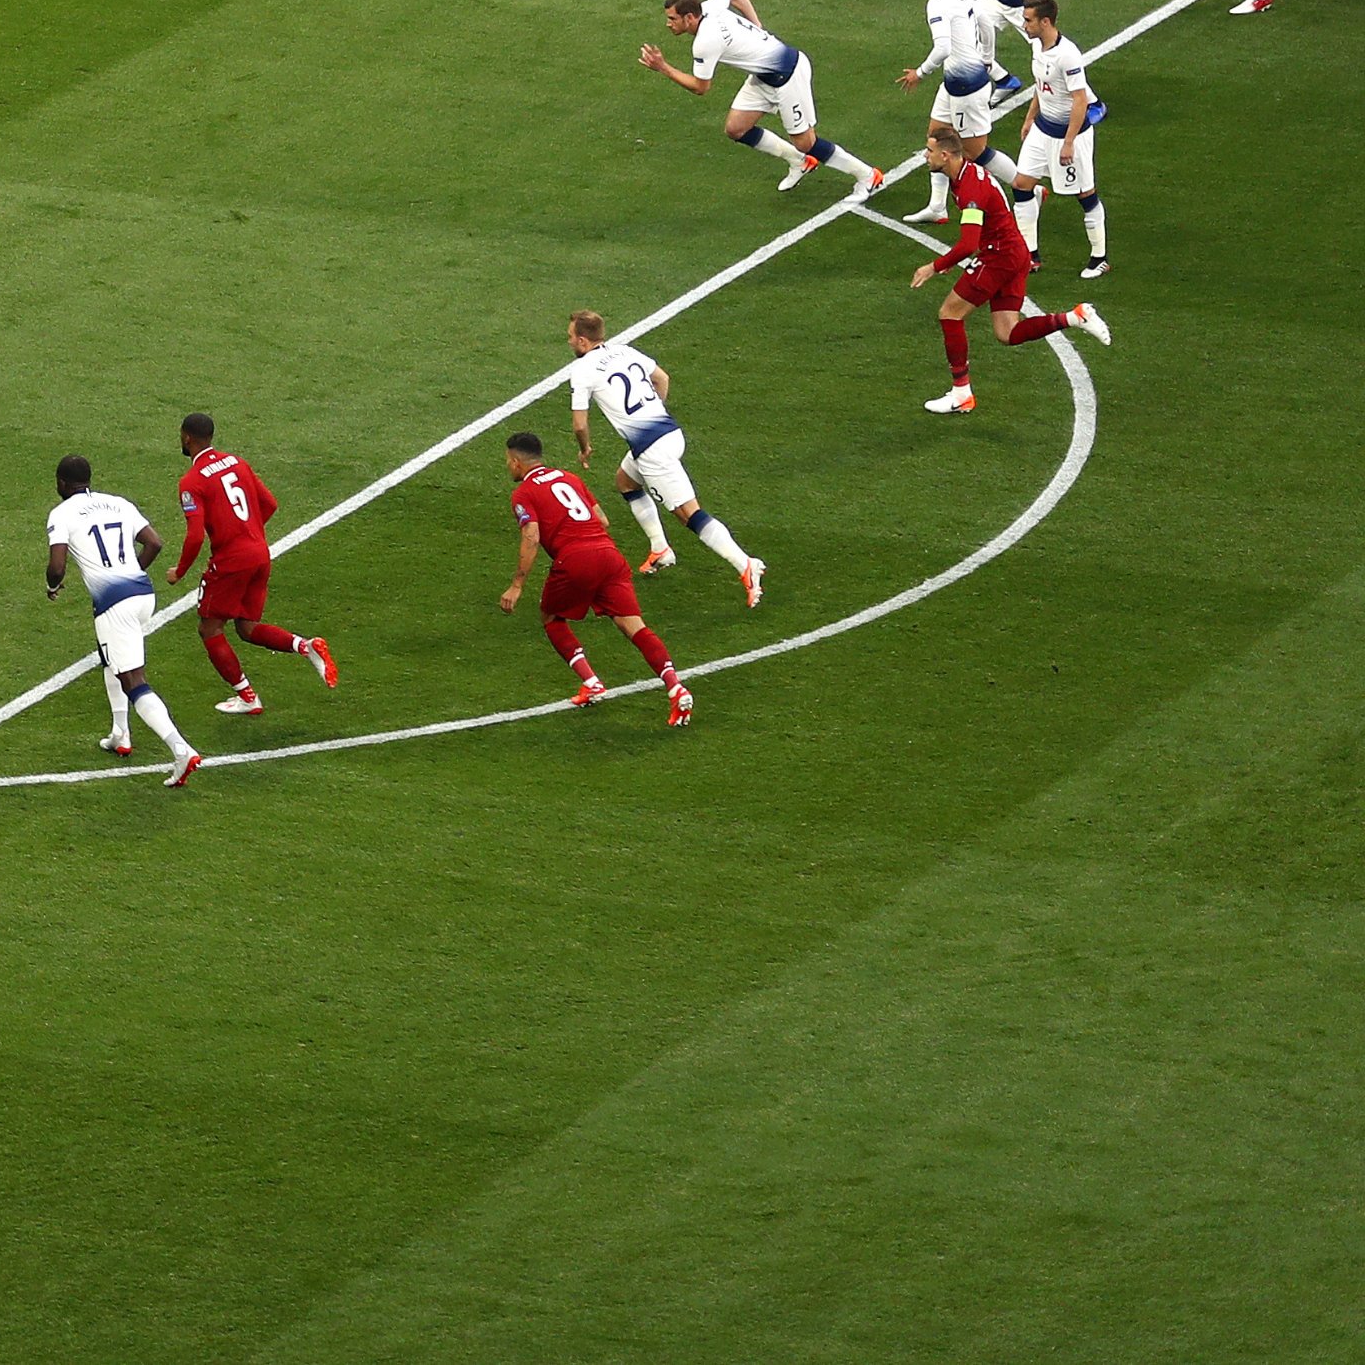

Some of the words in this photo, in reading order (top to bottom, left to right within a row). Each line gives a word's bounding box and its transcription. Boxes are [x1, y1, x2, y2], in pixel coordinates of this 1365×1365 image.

[792, 104, 803, 122] 5
[955, 112, 965, 129] 7
[1065, 166, 1077, 183] 8
[606, 362, 657, 417] 23
[220, 471, 251, 523] 5
[550, 481, 592, 523] 9
[89, 521, 126, 569] 17
